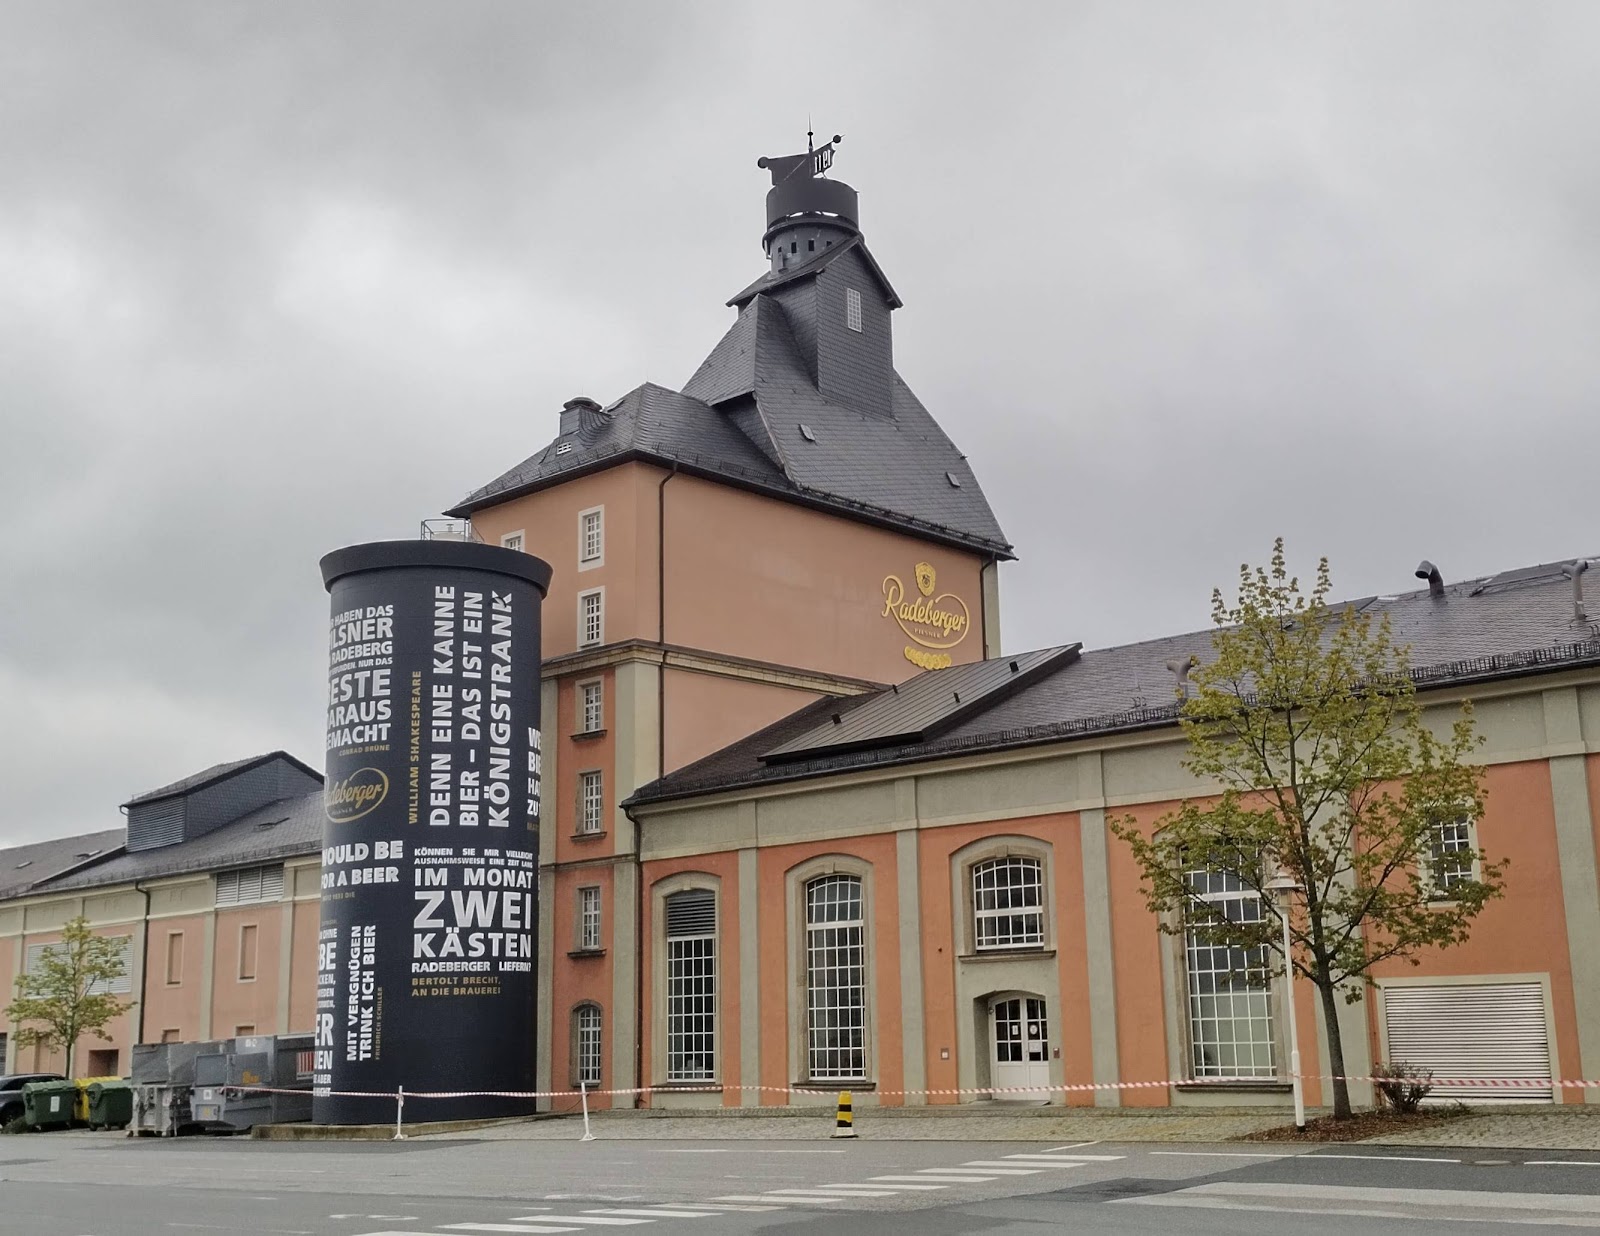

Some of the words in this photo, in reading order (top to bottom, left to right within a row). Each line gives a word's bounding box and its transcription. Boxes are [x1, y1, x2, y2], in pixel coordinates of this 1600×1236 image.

[334, 608, 362, 626] HABEN
[367, 604, 394, 617] DAS
[463, 592, 483, 633] EIN
[881, 575, 966, 637] Radeberger
[433, 586, 455, 674] KANNE
[332, 641, 393, 665] RADEBERG
[358, 659, 374, 668] NUR
[375, 657, 393, 666] DAS
[462, 641, 482, 678] IST
[330, 669, 391, 705] ESTE
[328, 699, 392, 729] ARAUS
[410, 671, 421, 762] SHAKESPEARE
[432, 685, 453, 742] EINE
[461, 688, 482, 740] DAS
[484, 590, 512, 828] KÖNIGSTRANK
[409, 766, 419, 824] WILLIAM
[430, 753, 452, 825] DENN
[460, 771, 480, 826] BIER
[526, 799, 541, 817] ZU
[374, 840, 403, 860] BE
[414, 847, 453, 856] KÖNNEN
[462, 848, 475, 856] SIE
[484, 849, 499, 857] MIR
[414, 857, 485, 865] AUSNAHMSWEISE
[489, 858, 505, 866] EINE
[337, 870, 348, 887] A
[351, 866, 399, 885] BEER
[414, 868, 448, 886] IM
[464, 868, 533, 889] MONAT
[413, 890, 532, 929] ZWEI
[363, 925, 376, 965] BIER
[413, 926, 532, 958] KÄSTEN
[348, 925, 361, 1026] VERGNÜGEN
[411, 962, 491, 973] RADEBERGER
[498, 961, 532, 972] LIEFERN?
[411, 977, 458, 986] BERTOLT
[361, 971, 375, 1000] ICH
[411, 988, 428, 997] AN
[431, 988, 449, 996] DIE
[453, 987, 501, 995] BRAUEREI
[347, 1031, 358, 1061] MIT
[359, 1006, 374, 1061] TRINK
